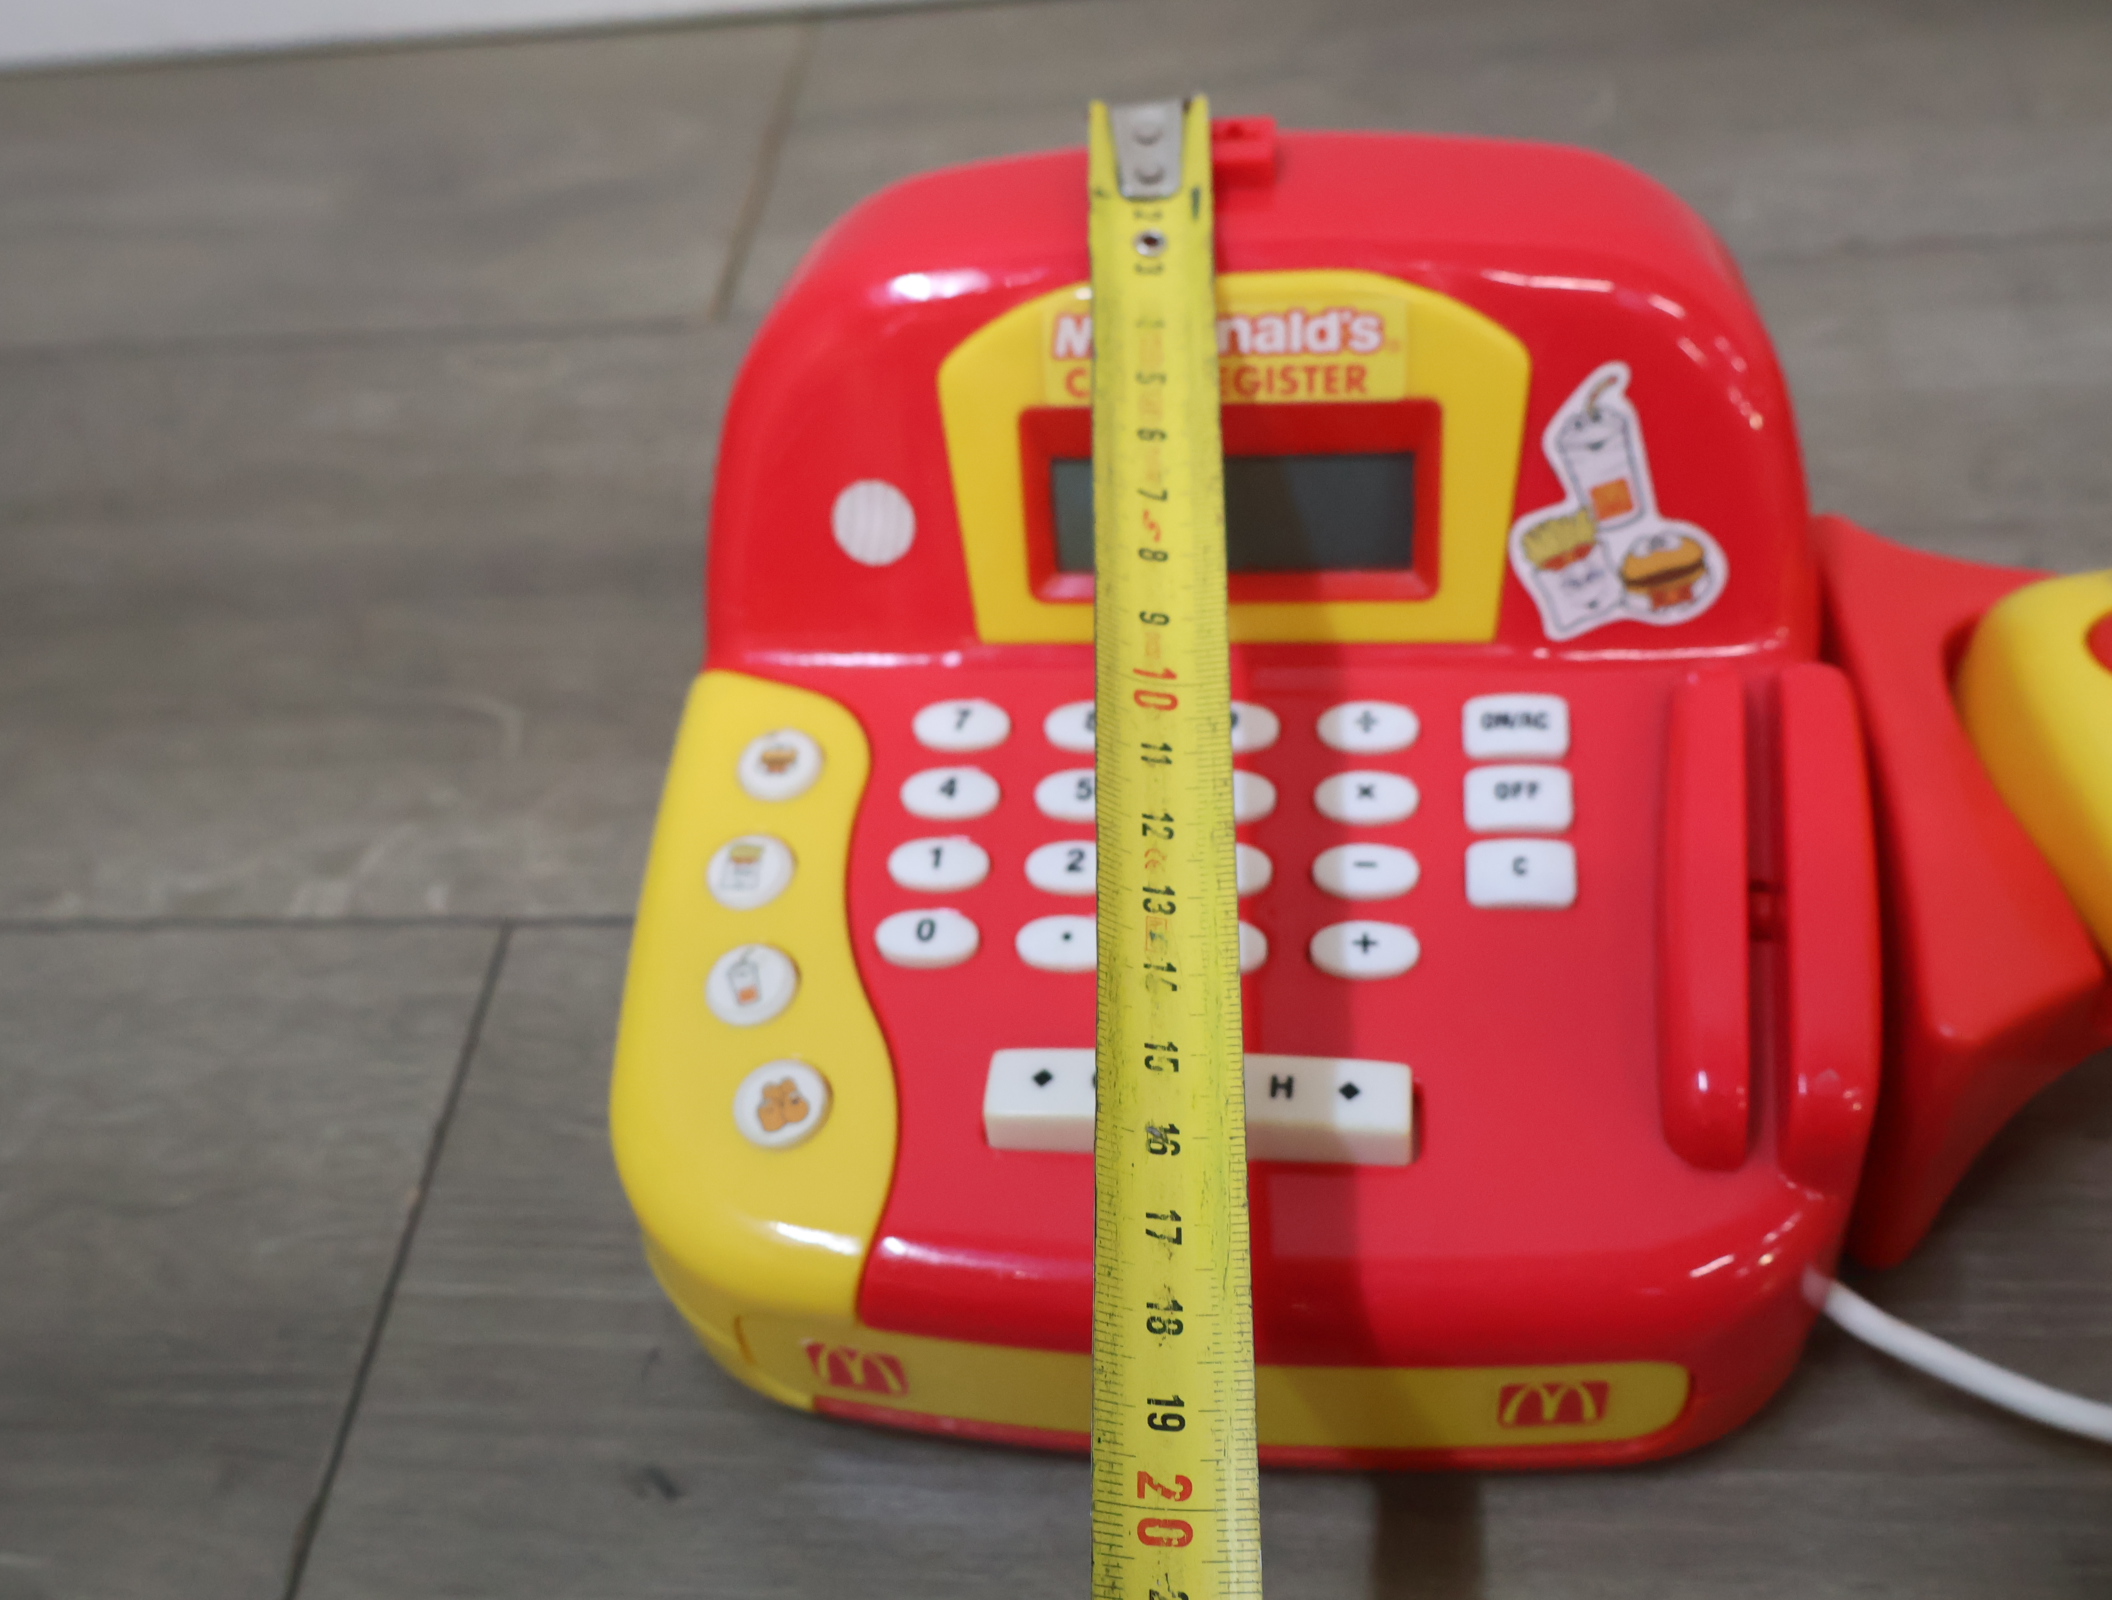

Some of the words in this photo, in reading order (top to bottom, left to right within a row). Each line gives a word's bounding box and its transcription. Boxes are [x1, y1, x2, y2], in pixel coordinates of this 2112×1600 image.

[1137, 427, 1168, 442] 6
[1137, 488, 1168, 502] 7
[1138, 547, 1169, 562] 8
[1139, 610, 1170, 626] 9
[1133, 667, 1180, 711] 10
[954, 707, 973, 731] 7
[1480, 710, 1549, 730] ON/AC
[1140, 742, 1173, 765] 11
[938, 776, 958, 799] 4
[1074, 777, 1094, 801] 5
[1493, 782, 1541, 799] OFF
[1141, 812, 1175, 841] 12
[929, 847, 943, 870] 1
[1064, 848, 1086, 874] 2
[1511, 856, 1528, 876] C
[1142, 885, 1176, 916] 13
[915, 917, 937, 943] 0
[1144, 1041, 1179, 1073] 15
[1145, 1123, 1181, 1156] 16
[1145, 1209, 1183, 1245] 17
[1146, 1299, 1184, 1336] 18
[1146, 1394, 1186, 1432] 19
[1136, 1470, 1194, 1548] 20
